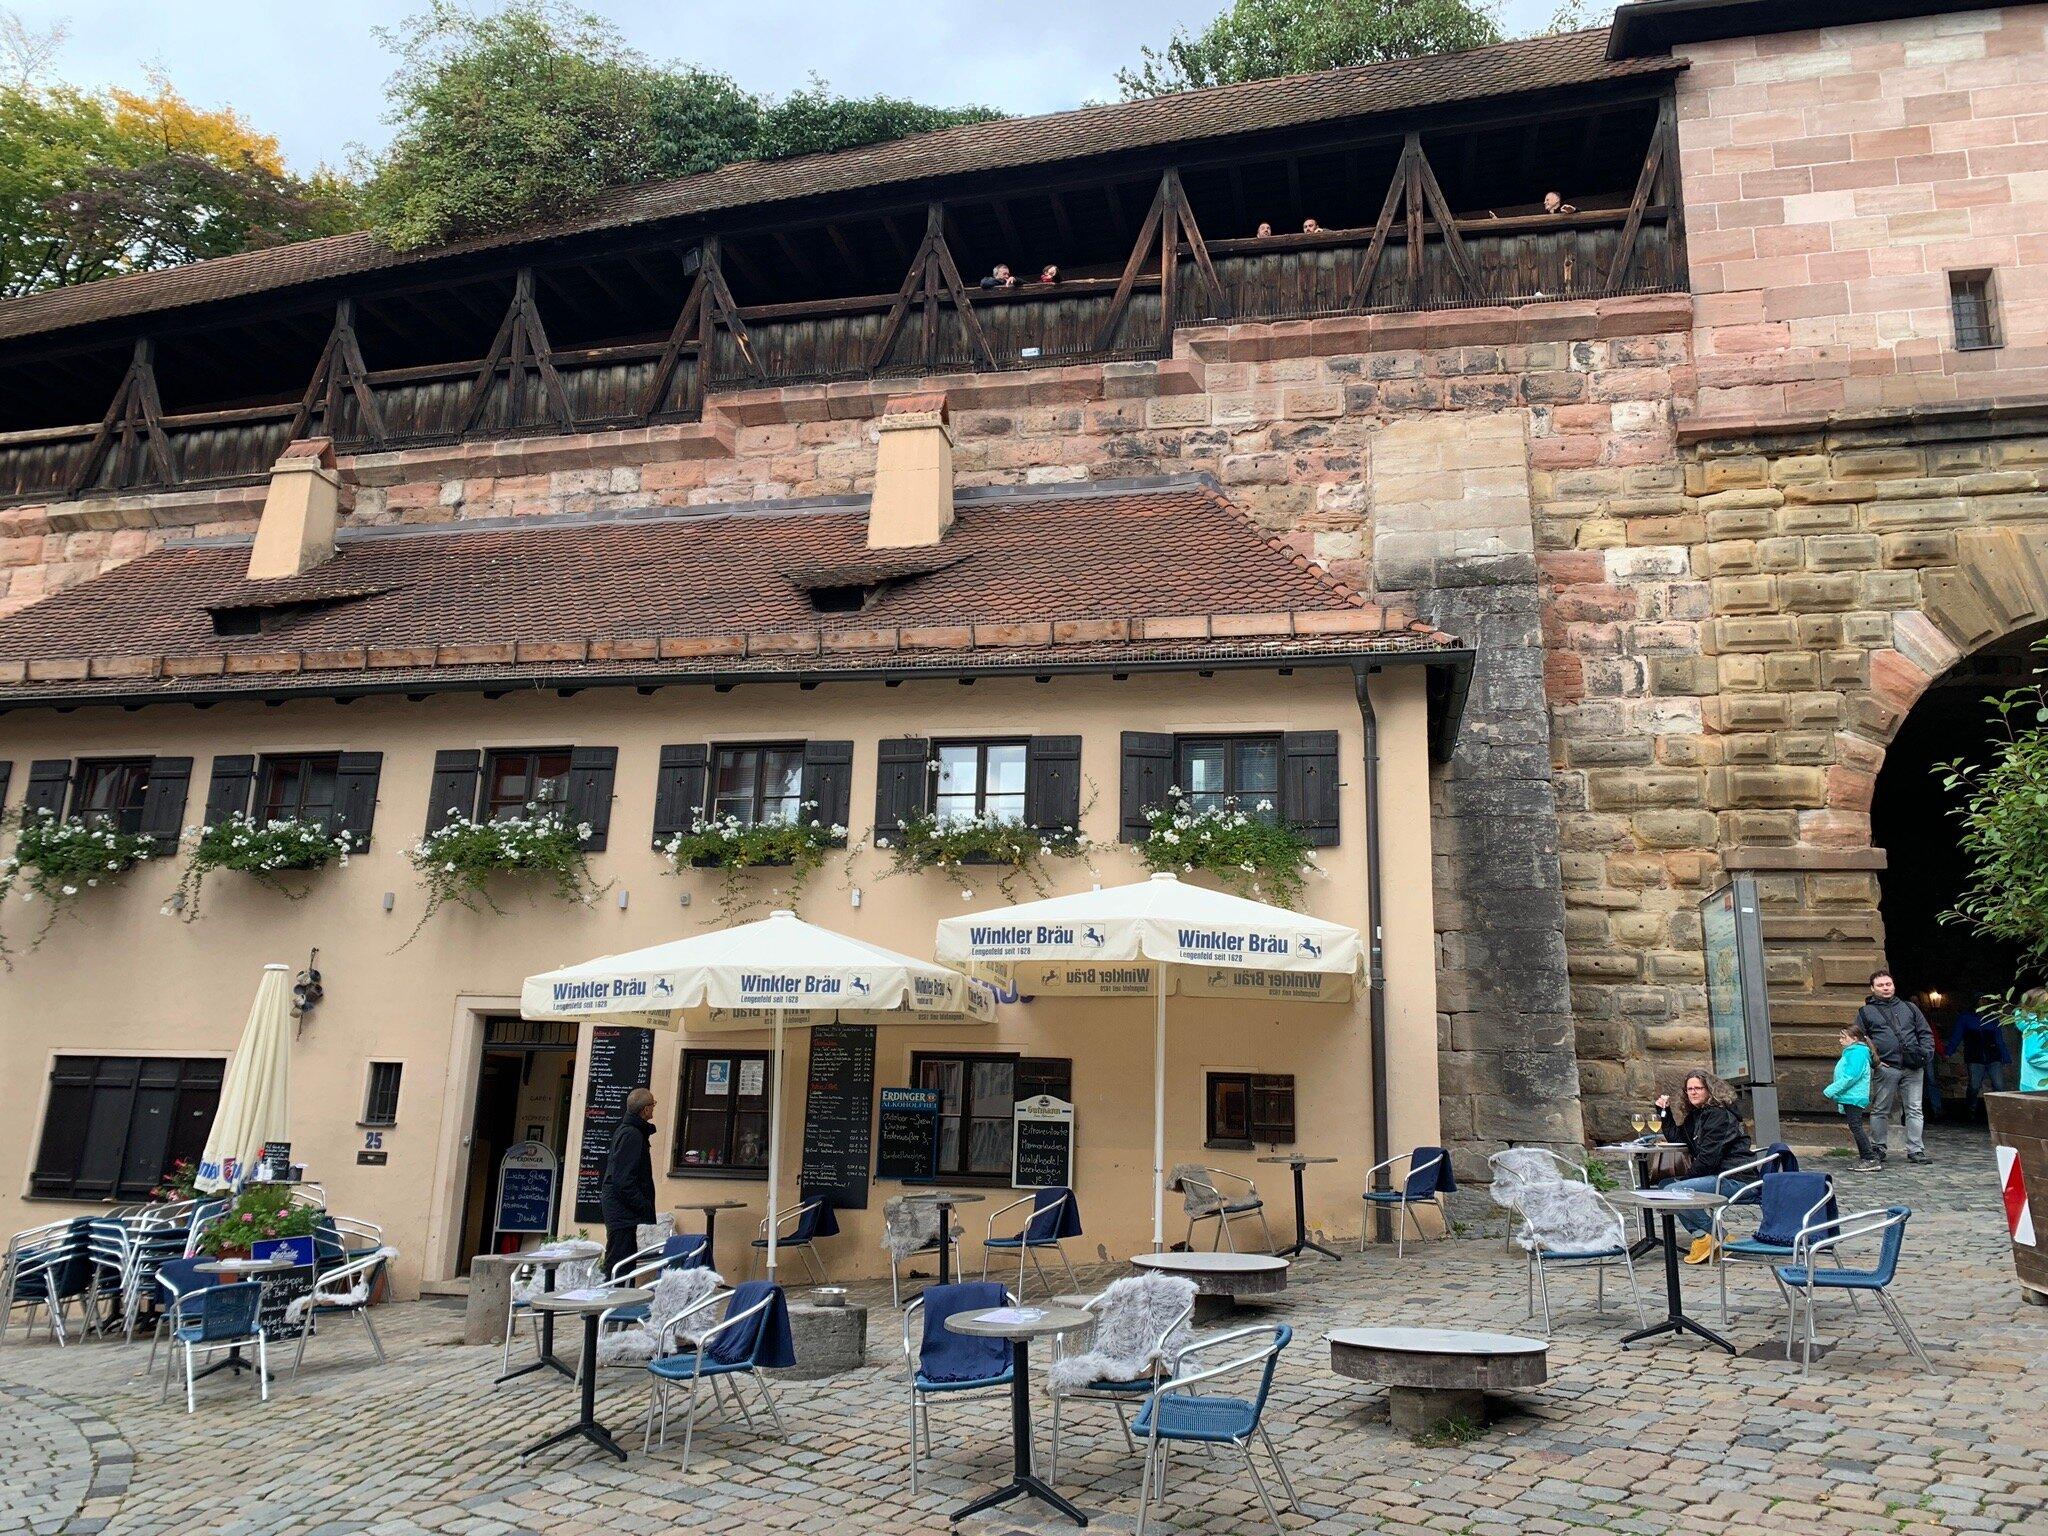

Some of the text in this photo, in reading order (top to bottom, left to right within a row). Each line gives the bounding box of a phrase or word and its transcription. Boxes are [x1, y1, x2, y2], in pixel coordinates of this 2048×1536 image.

[970, 925, 1074, 945] Winkler Bräu
[1178, 929, 1288, 954] Winkler Bräu
[971, 947, 1003, 956] Lengenfeld
[1017, 947, 1031, 955] 1628
[1179, 950, 1243, 963] Lengenfeld seit 1628
[553, 978, 647, 1001] Winkler Bräu
[741, 974, 841, 994] Winkler Bräu
[740, 994, 799, 1004] Lengenfeld seit 1628
[882, 1090, 926, 1103] ERDINGER
[881, 1101, 937, 1109] ALKOHOLFREI
[365, 1131, 383, 1150] 25
